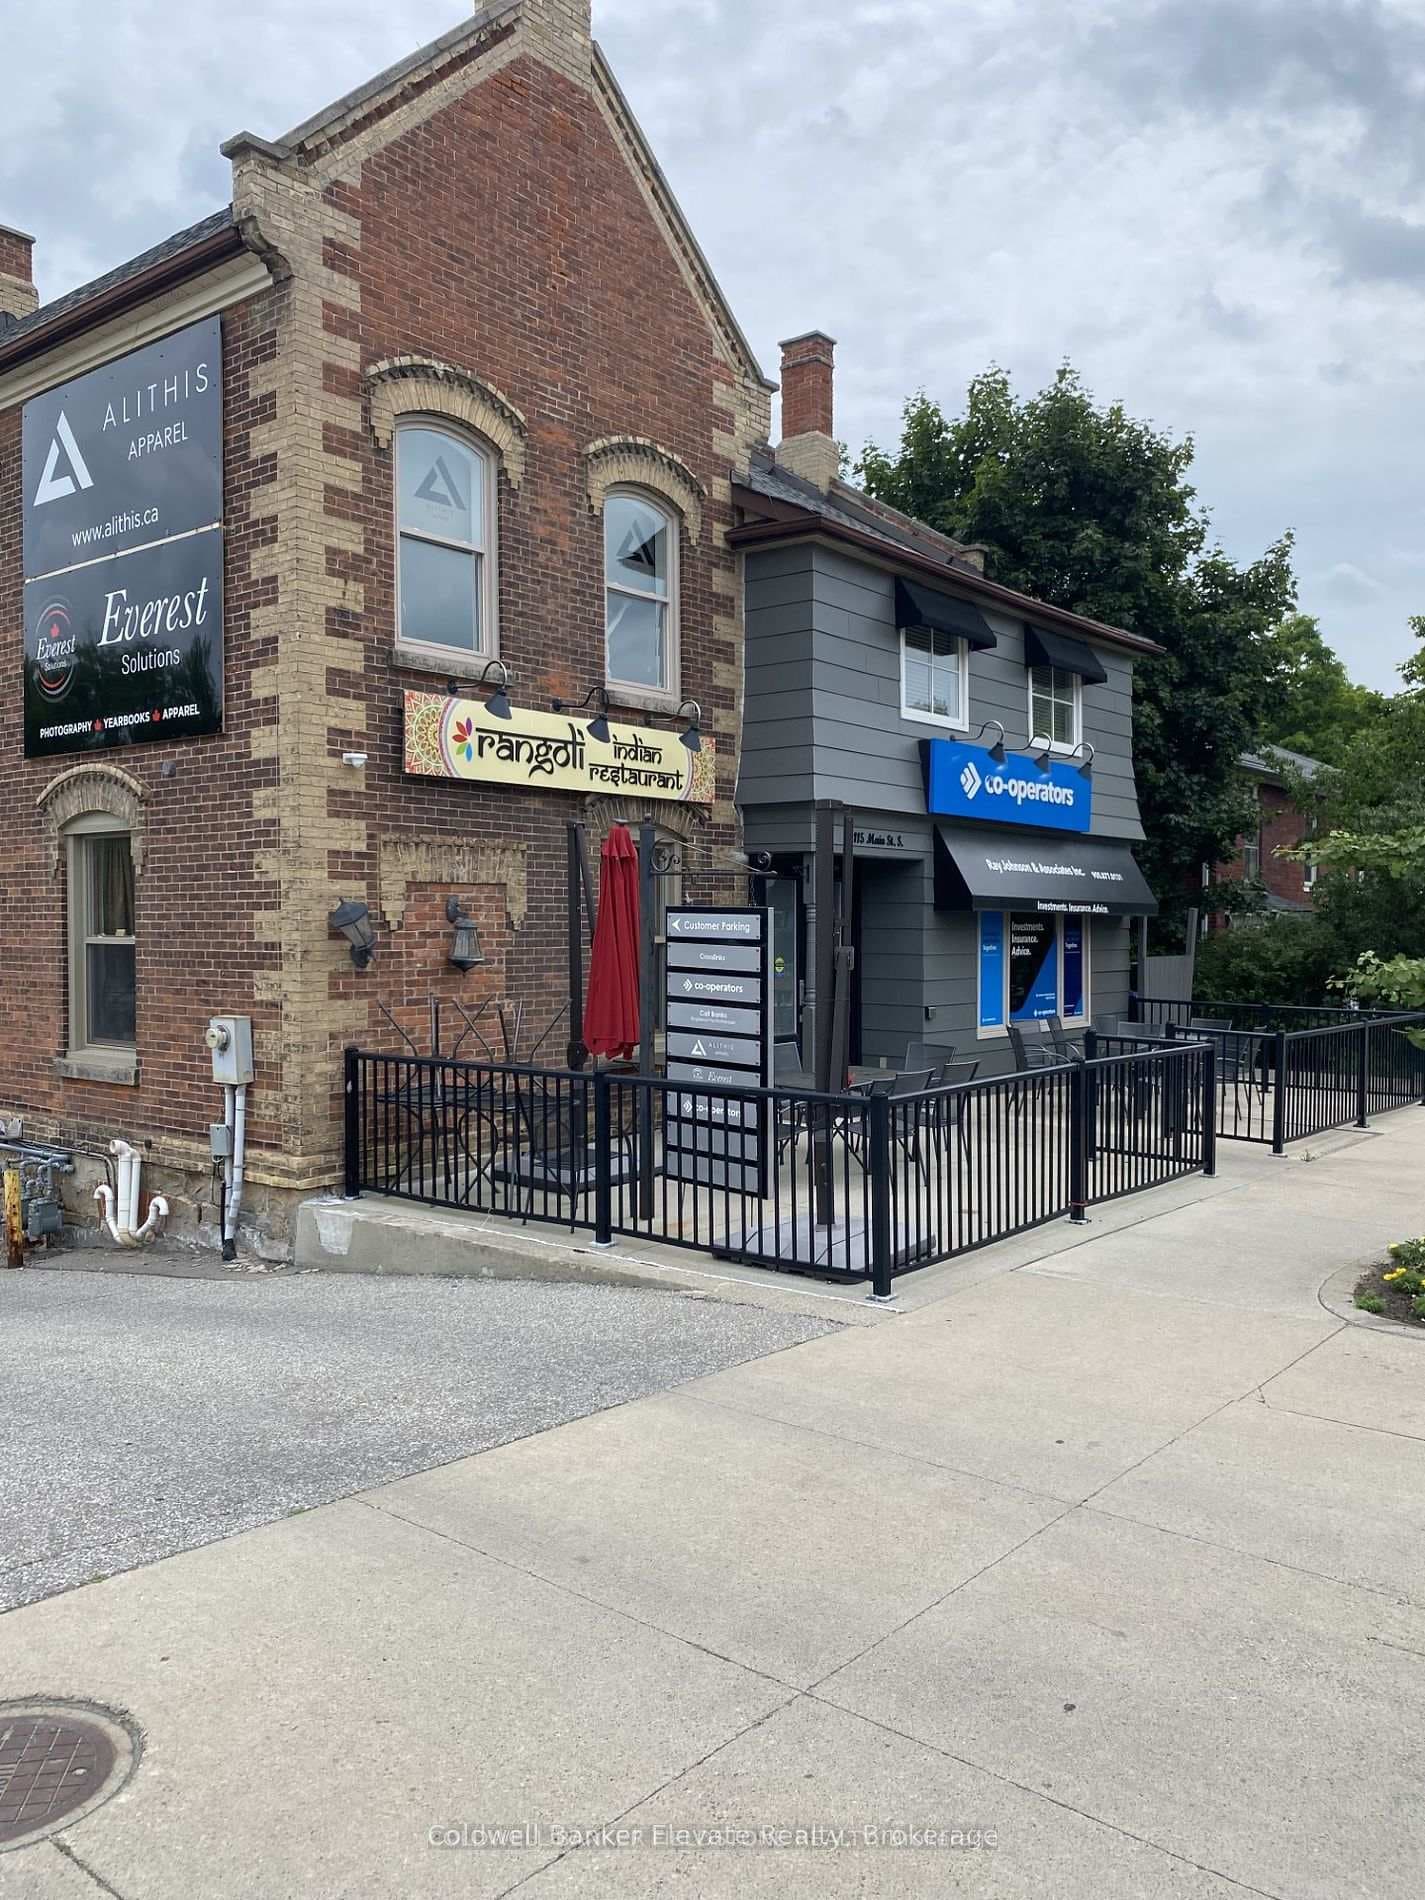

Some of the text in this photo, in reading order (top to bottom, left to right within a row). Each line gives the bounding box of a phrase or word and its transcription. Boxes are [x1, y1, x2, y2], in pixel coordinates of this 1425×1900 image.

[102, 363, 209, 431] ALITHIS
[128, 421, 189, 461] APPAREL
[71, 507, 159, 547] www.alithis.ca
[97, 577, 209, 647] Everest
[36, 634, 76, 660] Everest
[121, 648, 181, 675] Solutions
[39, 704, 200, 739] PHOTOGRAPHY YEARBOOKS APPAREL
[476, 723, 586, 778] rangoli
[612, 733, 663, 765] indian
[588, 763, 684, 790] restaurant
[984, 774, 1075, 806] co-operators
[866, 833, 885, 845] Main
[886, 834, 896, 847] St.
[1001, 860, 1033, 874] Johnson
[1038, 863, 1074, 876] Associates
[1037, 899, 1068, 912] Investments.
[683, 920, 751, 934] Customer Parking
[1011, 935, 1039, 943] Insurance.
[1011, 946, 1032, 956] Advice.
[694, 981, 744, 993] co-operators
